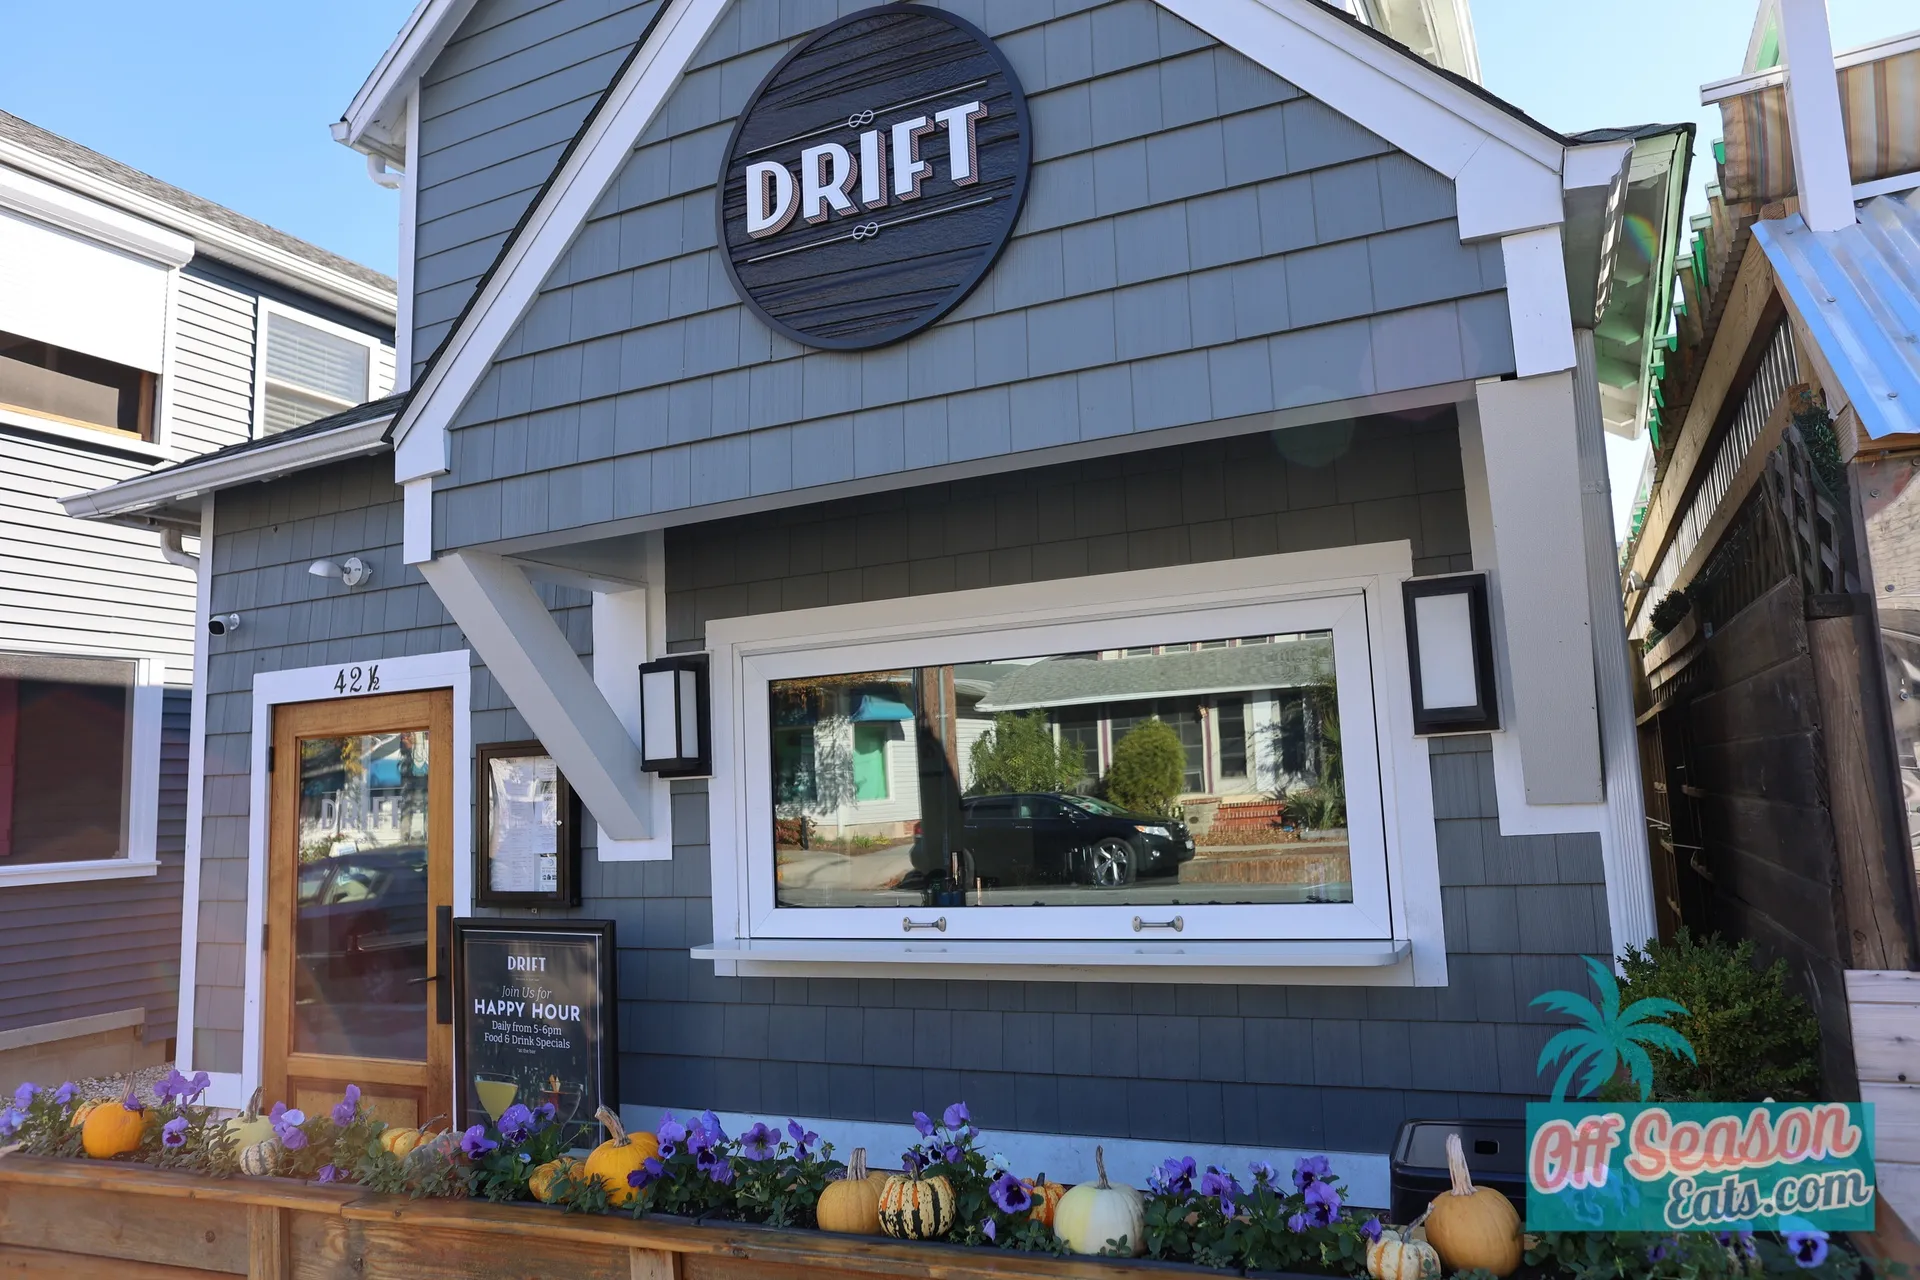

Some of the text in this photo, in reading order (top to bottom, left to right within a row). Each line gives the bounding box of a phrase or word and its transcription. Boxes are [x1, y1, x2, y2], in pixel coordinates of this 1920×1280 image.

[745, 100, 989, 240] DRIFT
[321, 796, 403, 829] DRIFT
[507, 955, 547, 972] DRIFT
[501, 985, 552, 1001] Join Us for
[474, 998, 581, 1022] HAPPY HOUR
[491, 1020, 562, 1037] Daily from 5-6pm
[484, 1032, 571, 1050] Food & Drink Specials
